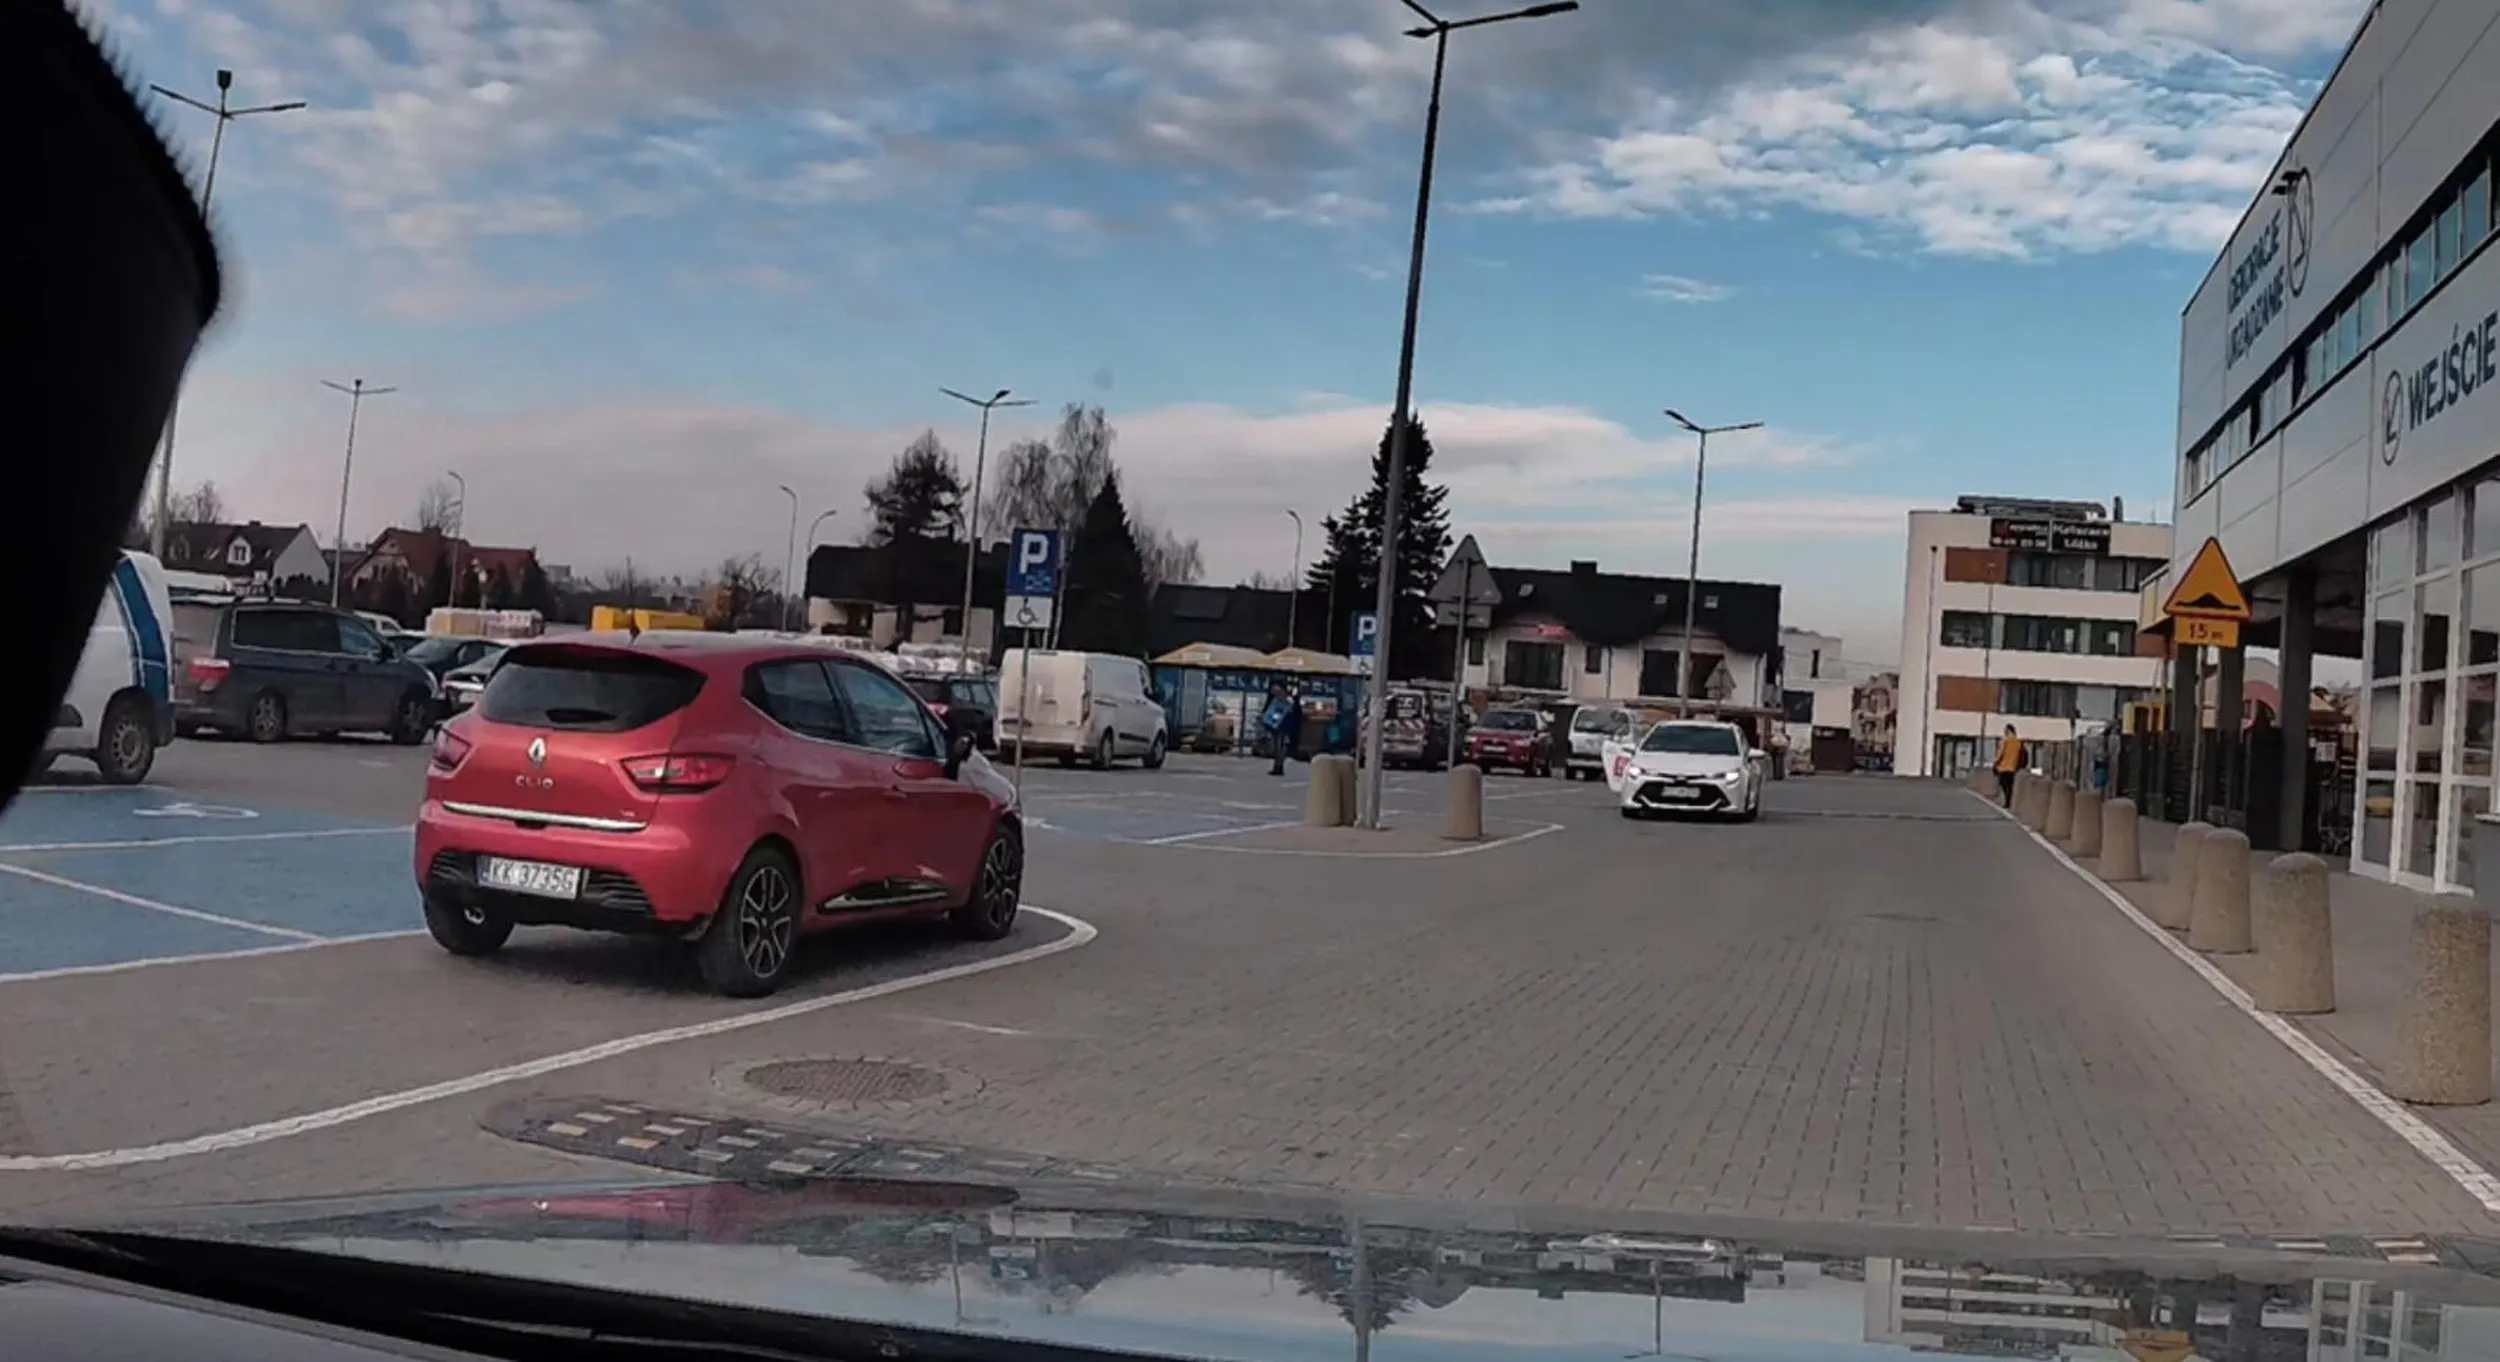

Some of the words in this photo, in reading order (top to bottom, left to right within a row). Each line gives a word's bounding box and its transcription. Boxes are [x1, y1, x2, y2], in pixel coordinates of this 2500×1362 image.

[2408, 311, 2498, 431] WEJŚCIE
[1019, 533, 1048, 574] P
[1358, 616, 1377, 640] P
[2190, 622, 2208, 639] 15
[515, 775, 554, 789] CLIO
[493, 860, 515, 882] KK
